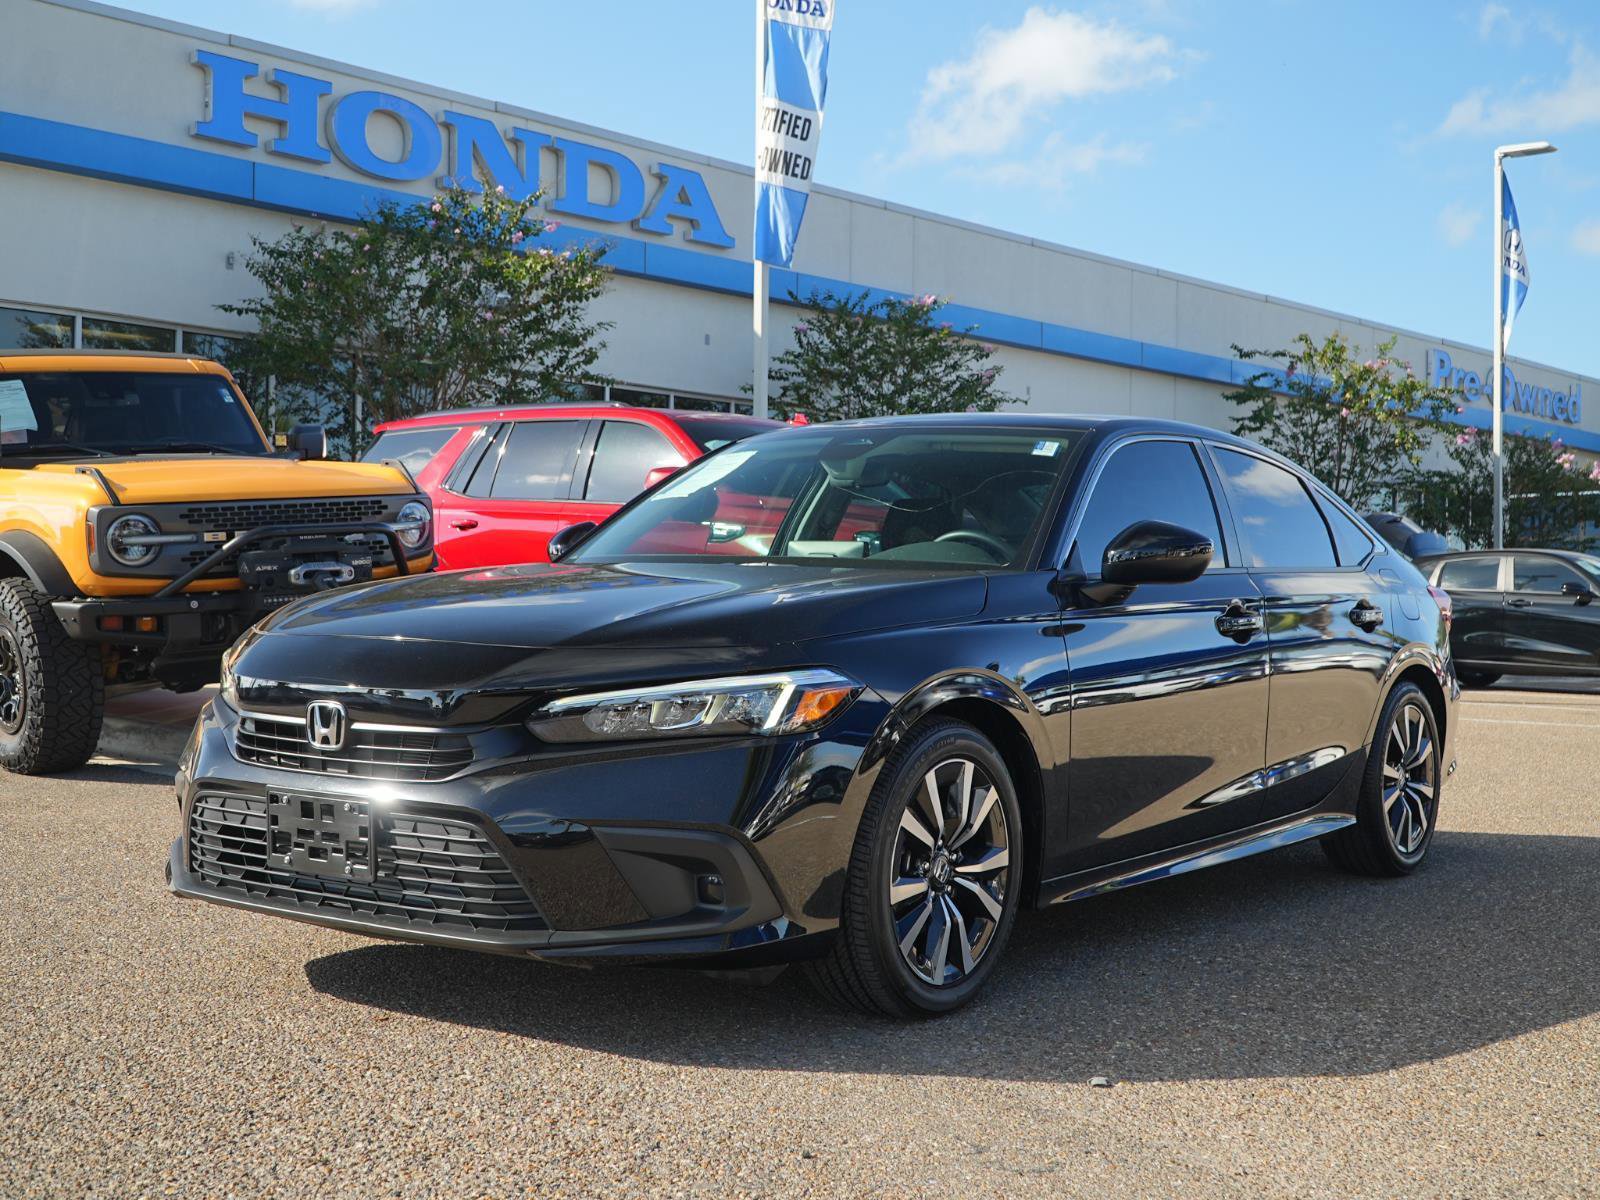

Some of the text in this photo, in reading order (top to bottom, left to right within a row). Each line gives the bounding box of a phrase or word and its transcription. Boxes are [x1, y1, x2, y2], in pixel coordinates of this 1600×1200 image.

[768, 0, 825, 17] ONDA
[762, 106, 812, 142] RTIFIED
[190, 49, 735, 249] HONDA
[758, 146, 812, 180] -OWNED
